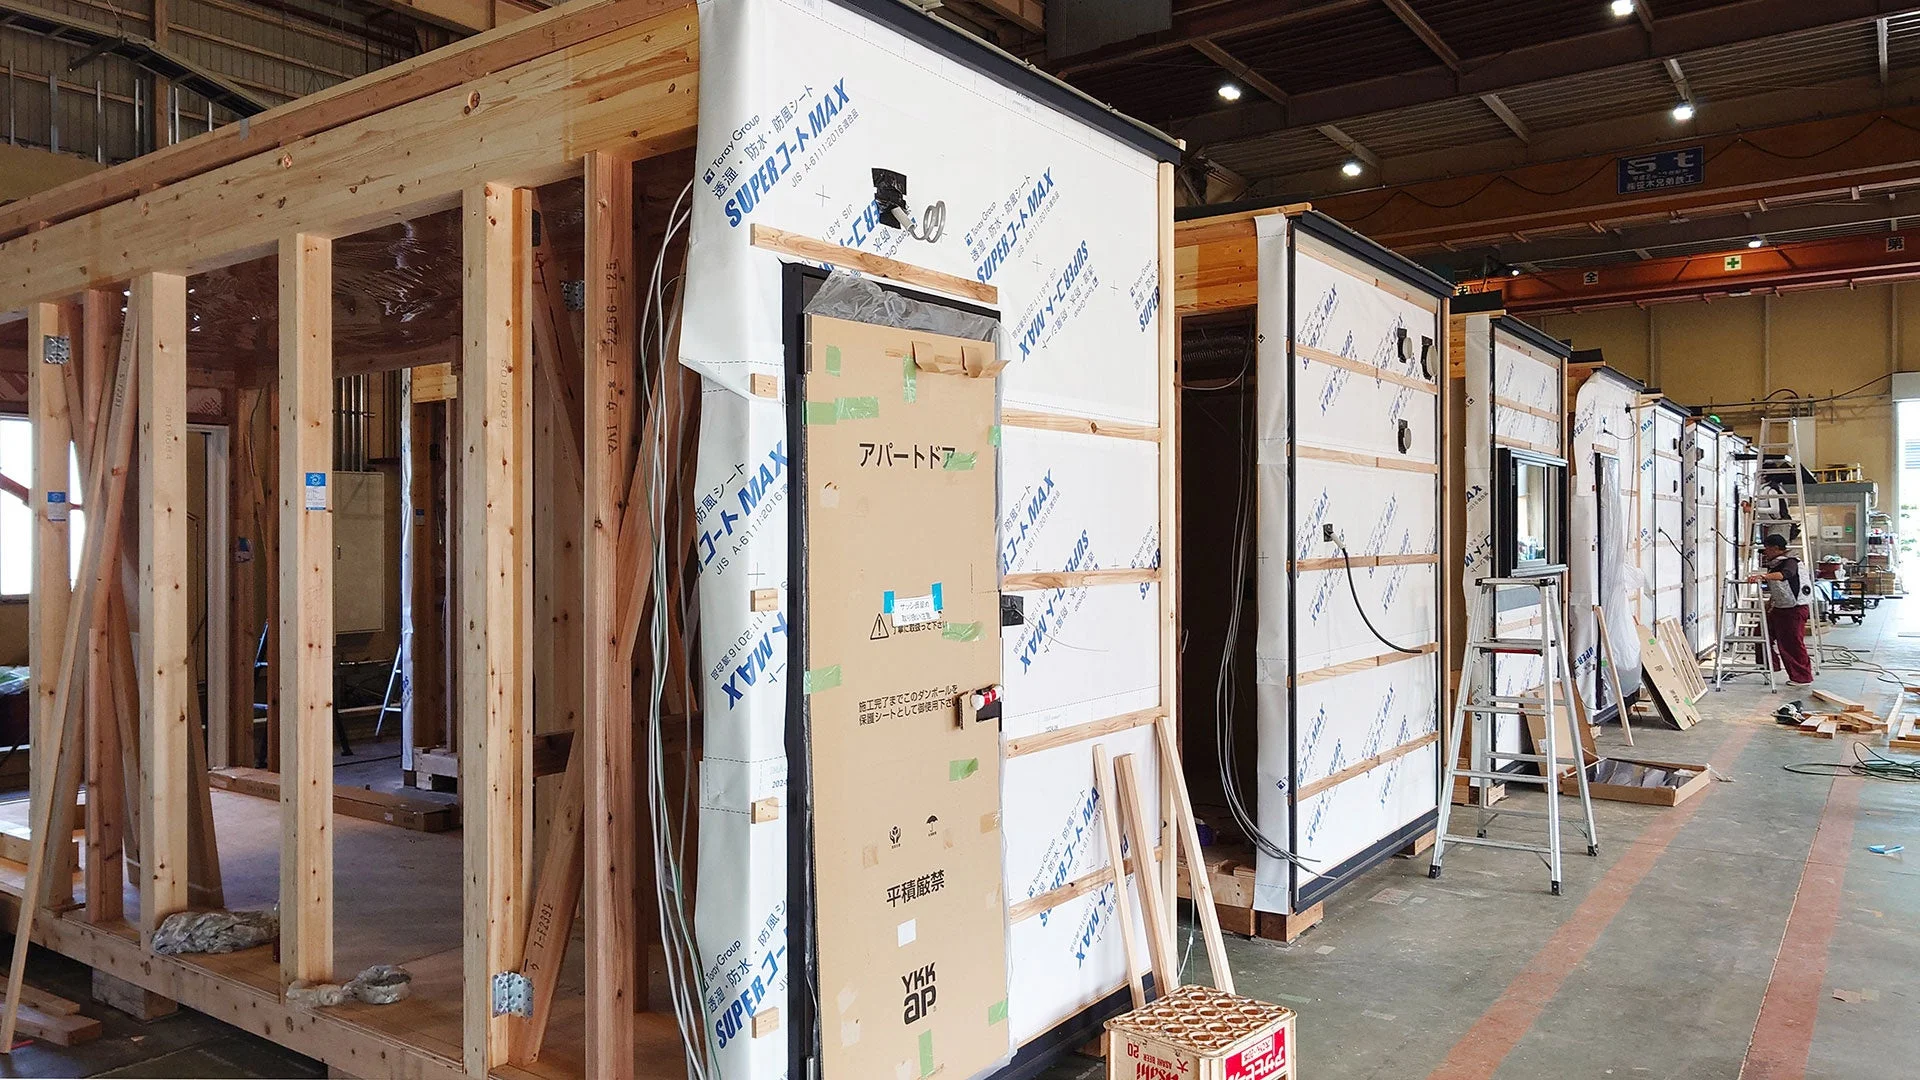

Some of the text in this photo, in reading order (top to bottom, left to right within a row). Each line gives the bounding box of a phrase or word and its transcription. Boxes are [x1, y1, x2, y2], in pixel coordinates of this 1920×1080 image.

[712, 114, 760, 169] Toray Group
[791, 171, 803, 188] JIS
[982, 201, 997, 221] Group
[1138, 285, 1160, 333] SUPER
[1641, 417, 1653, 432] MA
[859, 442, 955, 470] アパートドア
[695, 463, 745, 525] 防風シート
[1466, 485, 1482, 502] AX
[716, 557, 730, 576] JIS
[858, 684, 958, 713] 施工完了までこのダンボールを
[886, 869, 945, 908] 平積厳禁
[716, 939, 741, 967] Group
[901, 961, 936, 994] YKK
[1127, 1042, 1139, 1059] 20
[1176, 1058, 1189, 1074] 大
